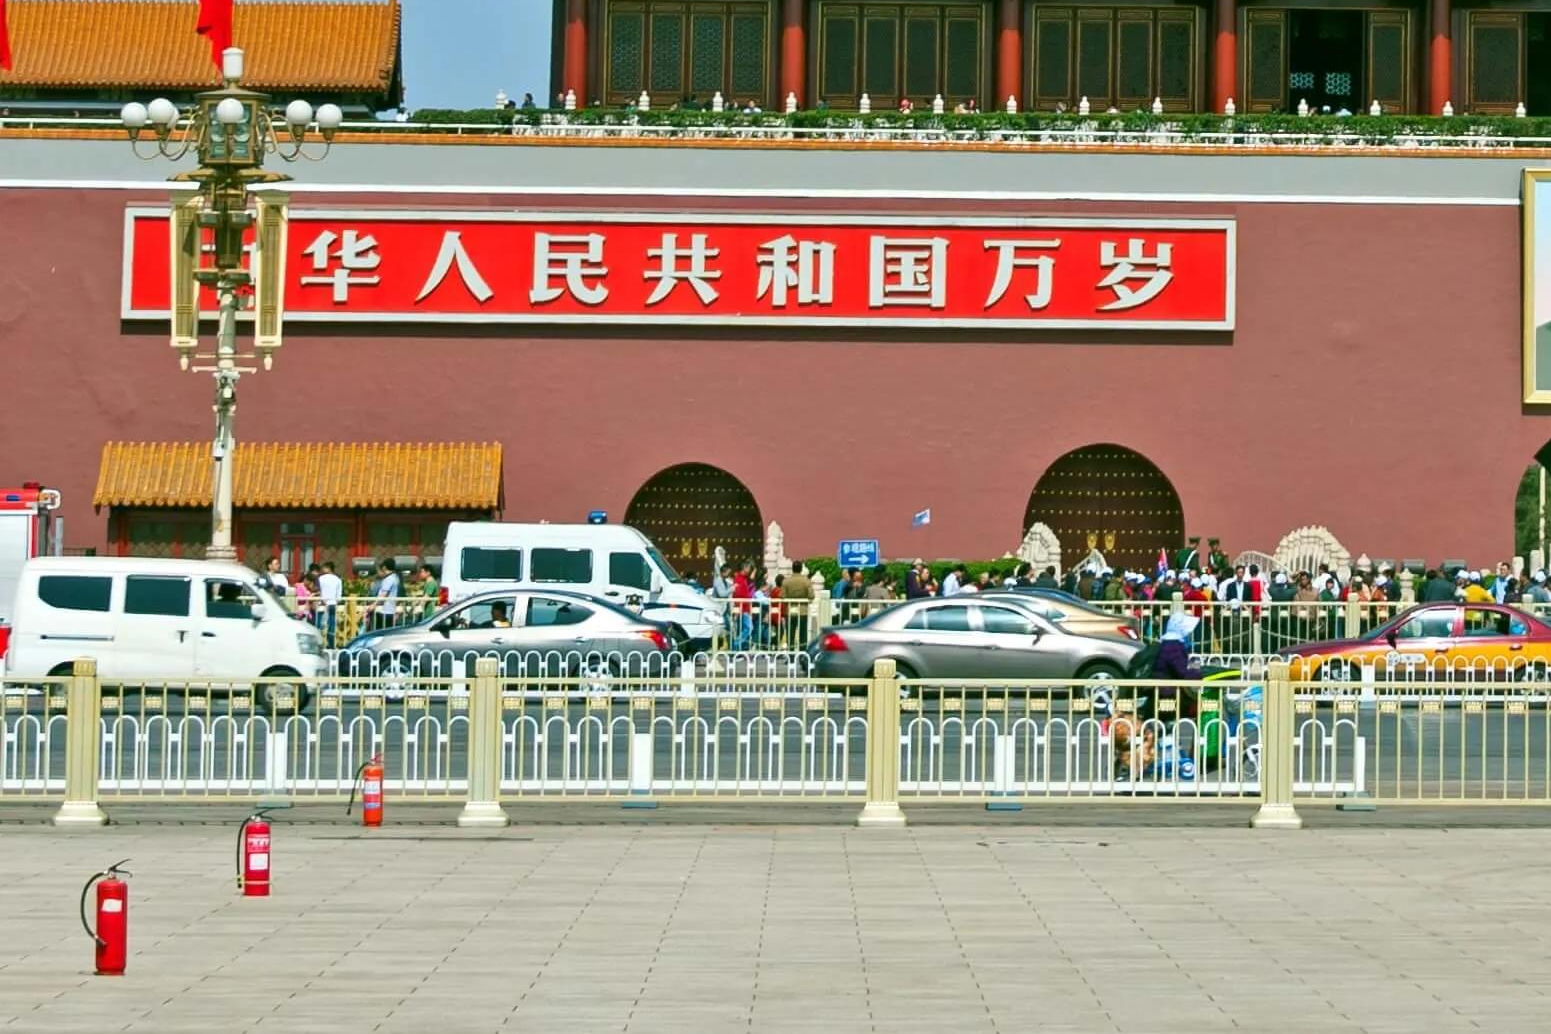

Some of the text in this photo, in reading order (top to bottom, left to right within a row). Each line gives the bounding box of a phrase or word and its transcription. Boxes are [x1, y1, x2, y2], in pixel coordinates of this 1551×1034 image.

[200, 230, 1174, 310] 华人民共和国万岁
